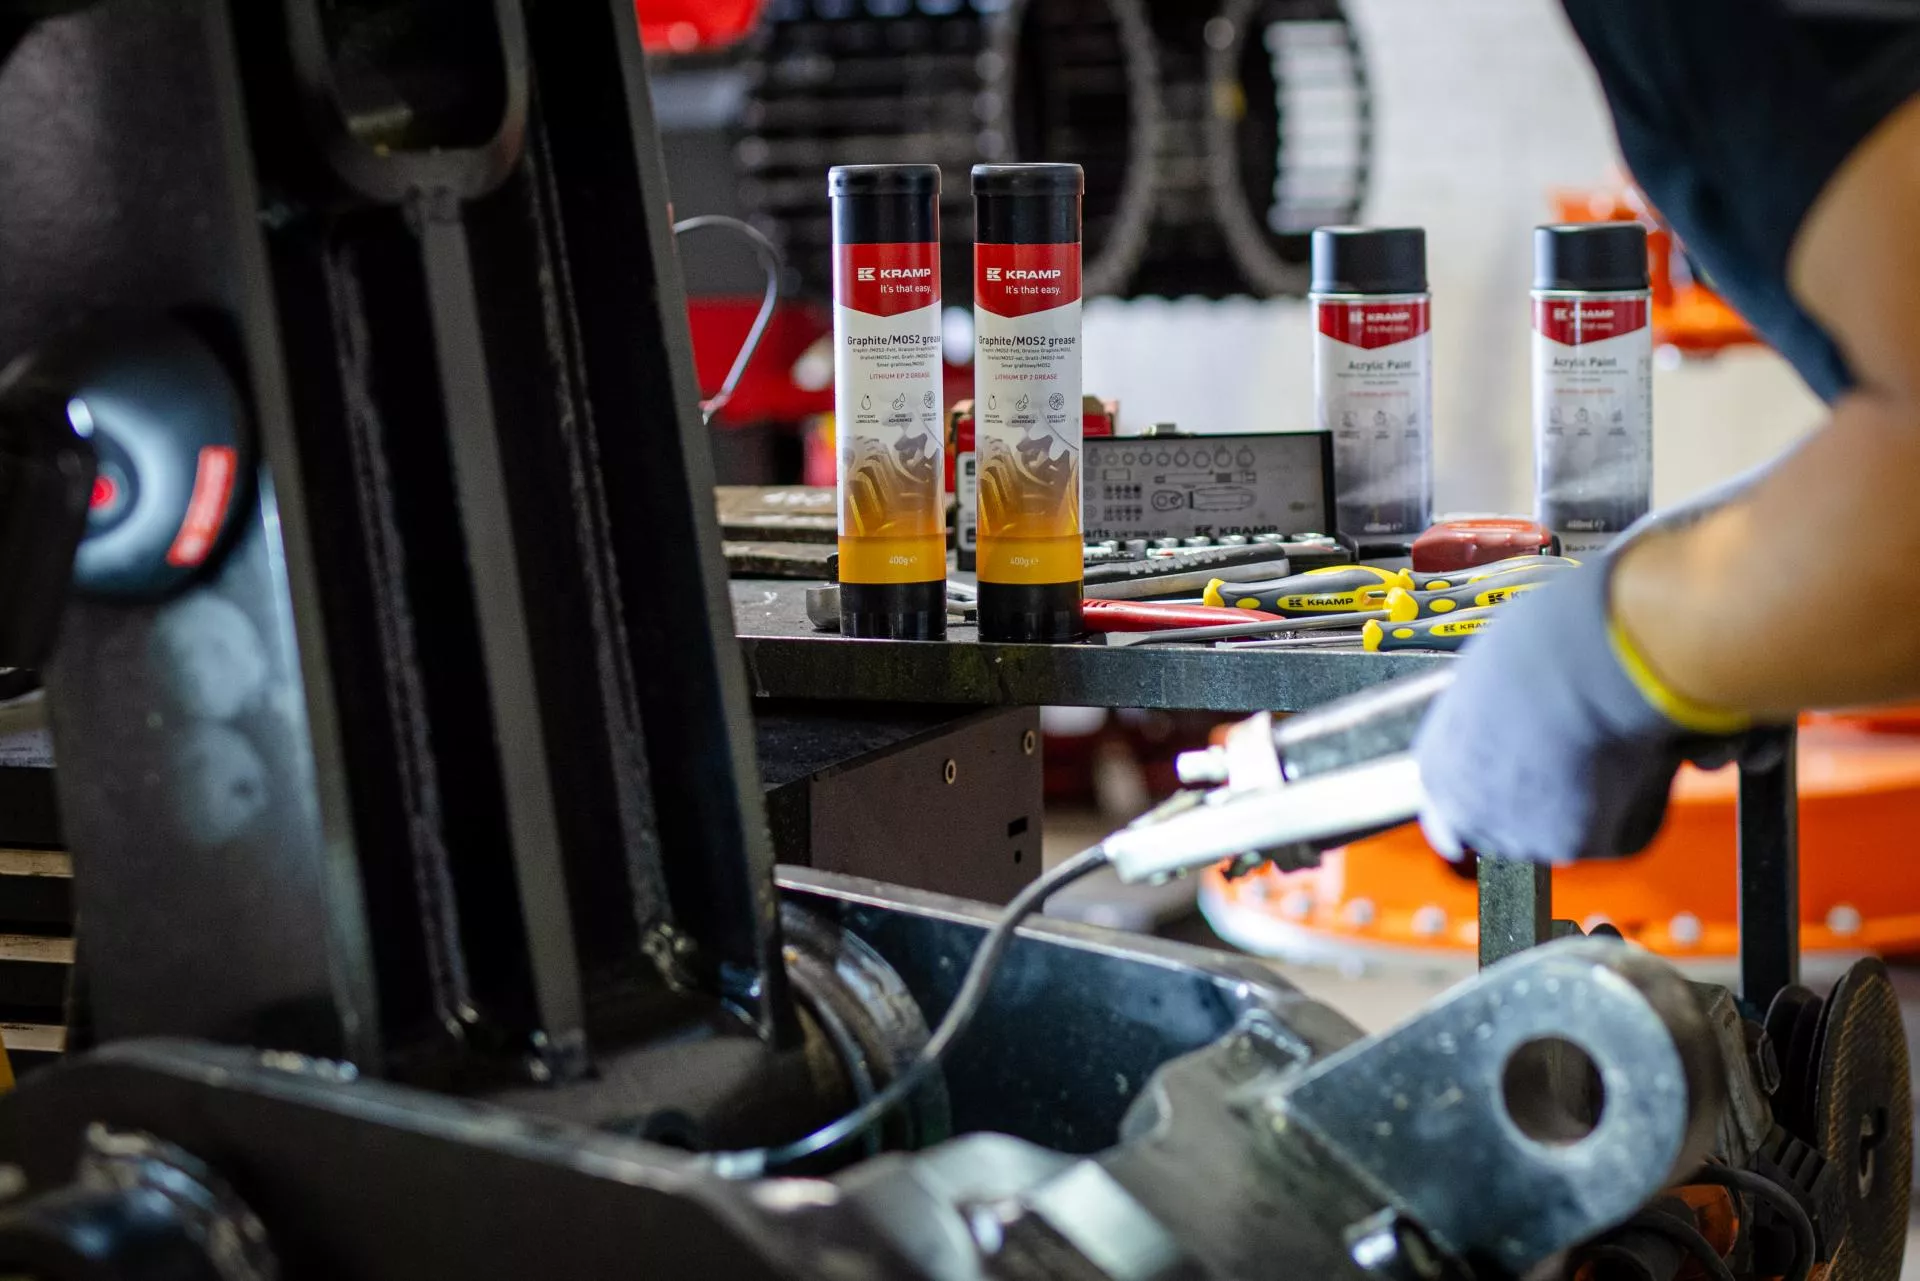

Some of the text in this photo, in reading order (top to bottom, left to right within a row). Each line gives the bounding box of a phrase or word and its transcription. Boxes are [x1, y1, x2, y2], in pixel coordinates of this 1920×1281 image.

[880, 268, 931, 279] KRAMP
[1005, 269, 1061, 280] KRAMP
[881, 284, 931, 294] It's that easy.
[1005, 285, 1061, 296] It's that easy.
[847, 334, 920, 347] Graphite/MOS2
[979, 335, 1076, 347] Graphite/MOS2 grease
[1348, 360, 1412, 371] Acrylic Paint
[1589, 356, 1617, 367] Paint
[1218, 525, 1279, 536] KRAMP
[889, 556, 909, 565] 400g
[1010, 556, 1029, 566] 400g
[1307, 598, 1354, 606] KRAMP
